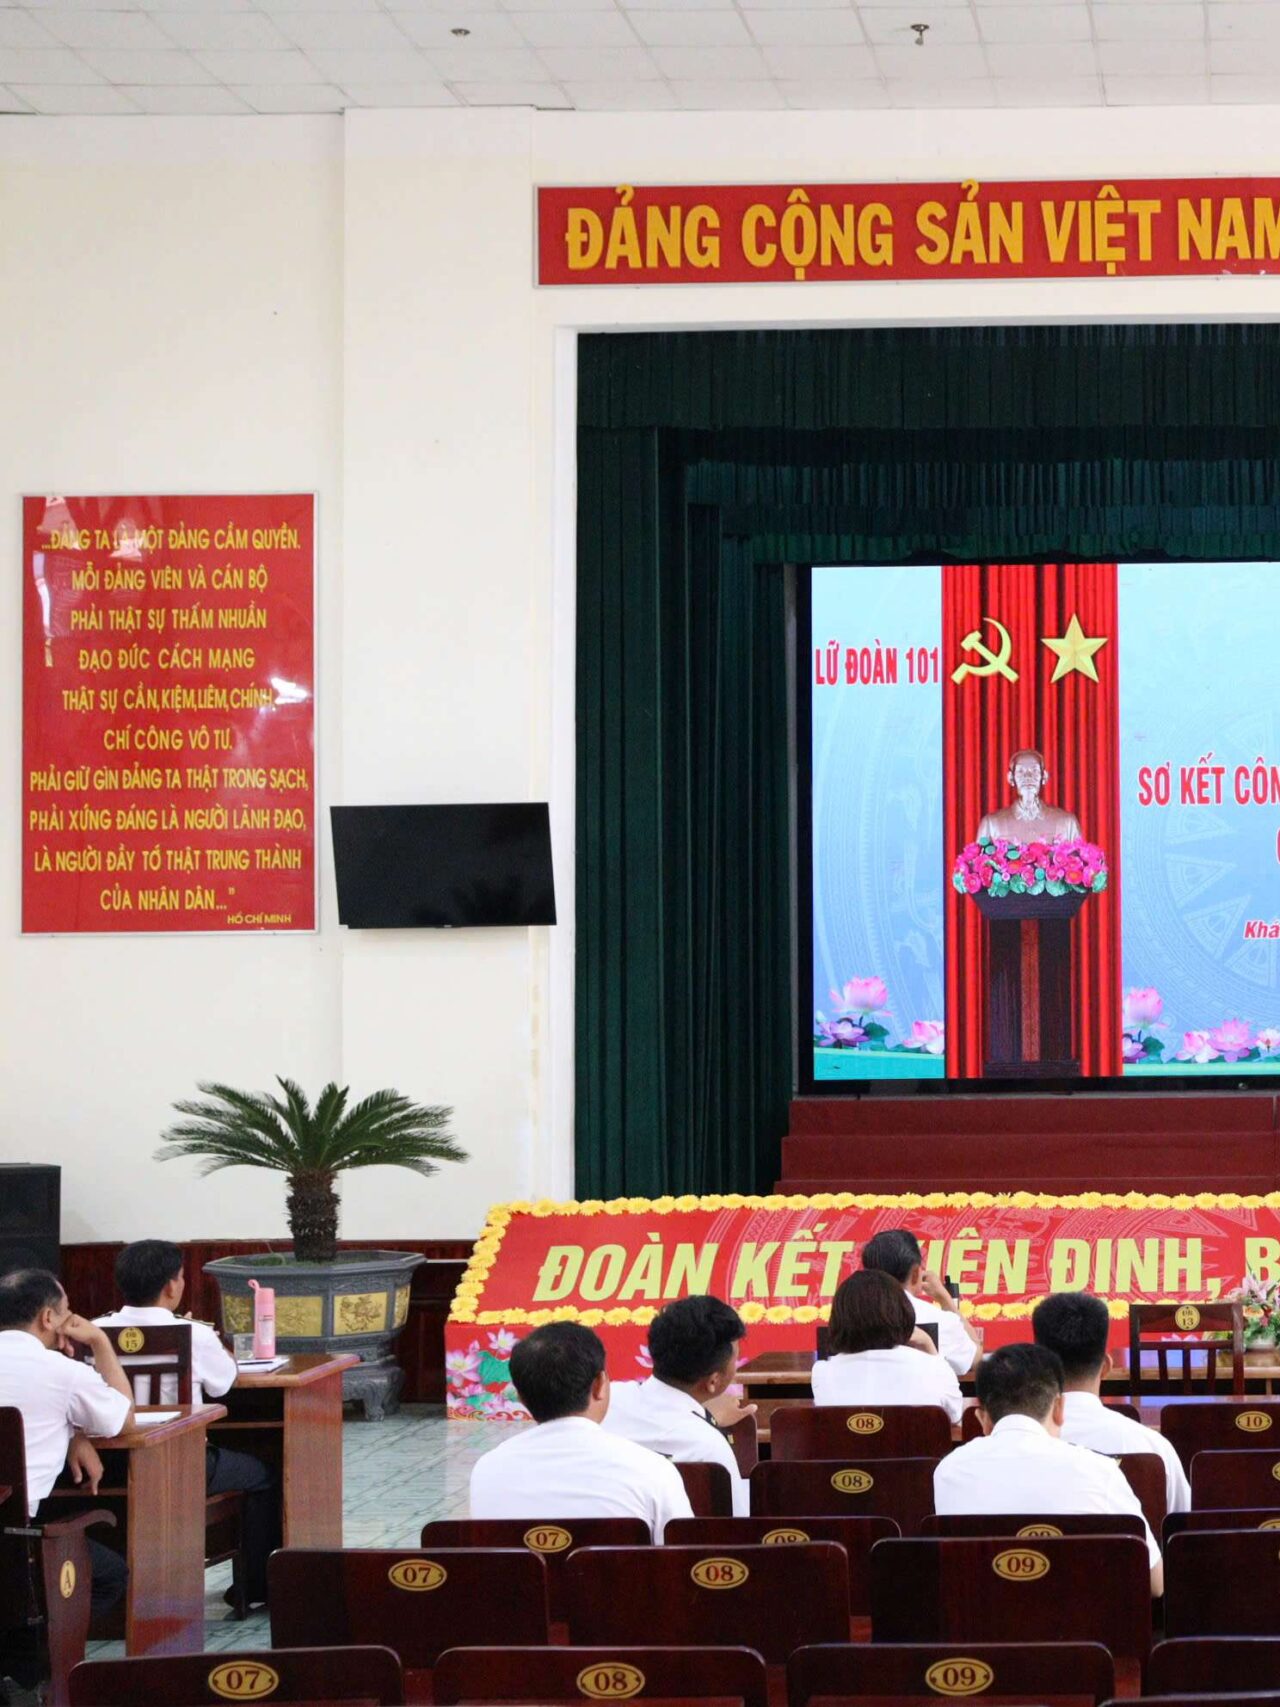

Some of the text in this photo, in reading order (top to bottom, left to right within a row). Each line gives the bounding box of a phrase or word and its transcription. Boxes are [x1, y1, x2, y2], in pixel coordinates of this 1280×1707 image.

[565, 184, 720, 270] ĐẢNG
[741, 187, 893, 280] CỘNG
[915, 178, 1024, 267] SẢN
[1041, 185, 1160, 275] VIỆT
[95, 522, 210, 554] TA MỘT ĐẢNG
[72, 561, 267, 592] MỖI ĐẢNG VIÊN VÀ CÁN BỘ
[71, 602, 213, 635] PHẢI THẬT SỰ THẤM
[79, 643, 255, 673] ĐẠO ĐỨC CÁCH MẠNG
[816, 639, 938, 685] LỮ ĐOÀN 101
[62, 688, 117, 713] THẬT SỰ
[103, 724, 209, 750] CHÍ CÔNG VÔ
[30, 761, 266, 793] PHẢI GIỮ GÌN ĐẢNG TA THẬT TRONG
[1138, 762, 1171, 806] SƠ
[1181, 752, 1225, 804] KẾT
[30, 803, 270, 831] PHẢI XỨNG ĐÁNG LÀ NGƯỜI LÃNH
[35, 843, 301, 874] LÀ NGƯỜI TỚ THẬT TRUNG THÀNH
[100, 883, 179, 910] CỦA NHÂN
[245, 913, 291, 923] CHÍ MINH
[532, 1232, 719, 1302] ĐOÀN
[730, 1222, 854, 1298] KẾT
[917, 1227, 1030, 1295] IÊN
[856, 1418, 875, 1429] 08
[1245, 1416, 1263, 1428] 10
[842, 1476, 863, 1488] 08
[536, 1532, 559, 1546] 07
[404, 1567, 431, 1584] 07
[705, 1566, 733, 1580] 08
[1007, 1558, 1035, 1573] 09
[226, 1671, 260, 1689] 07
[594, 1672, 628, 1690] 08
[943, 1667, 976, 1686] 09
